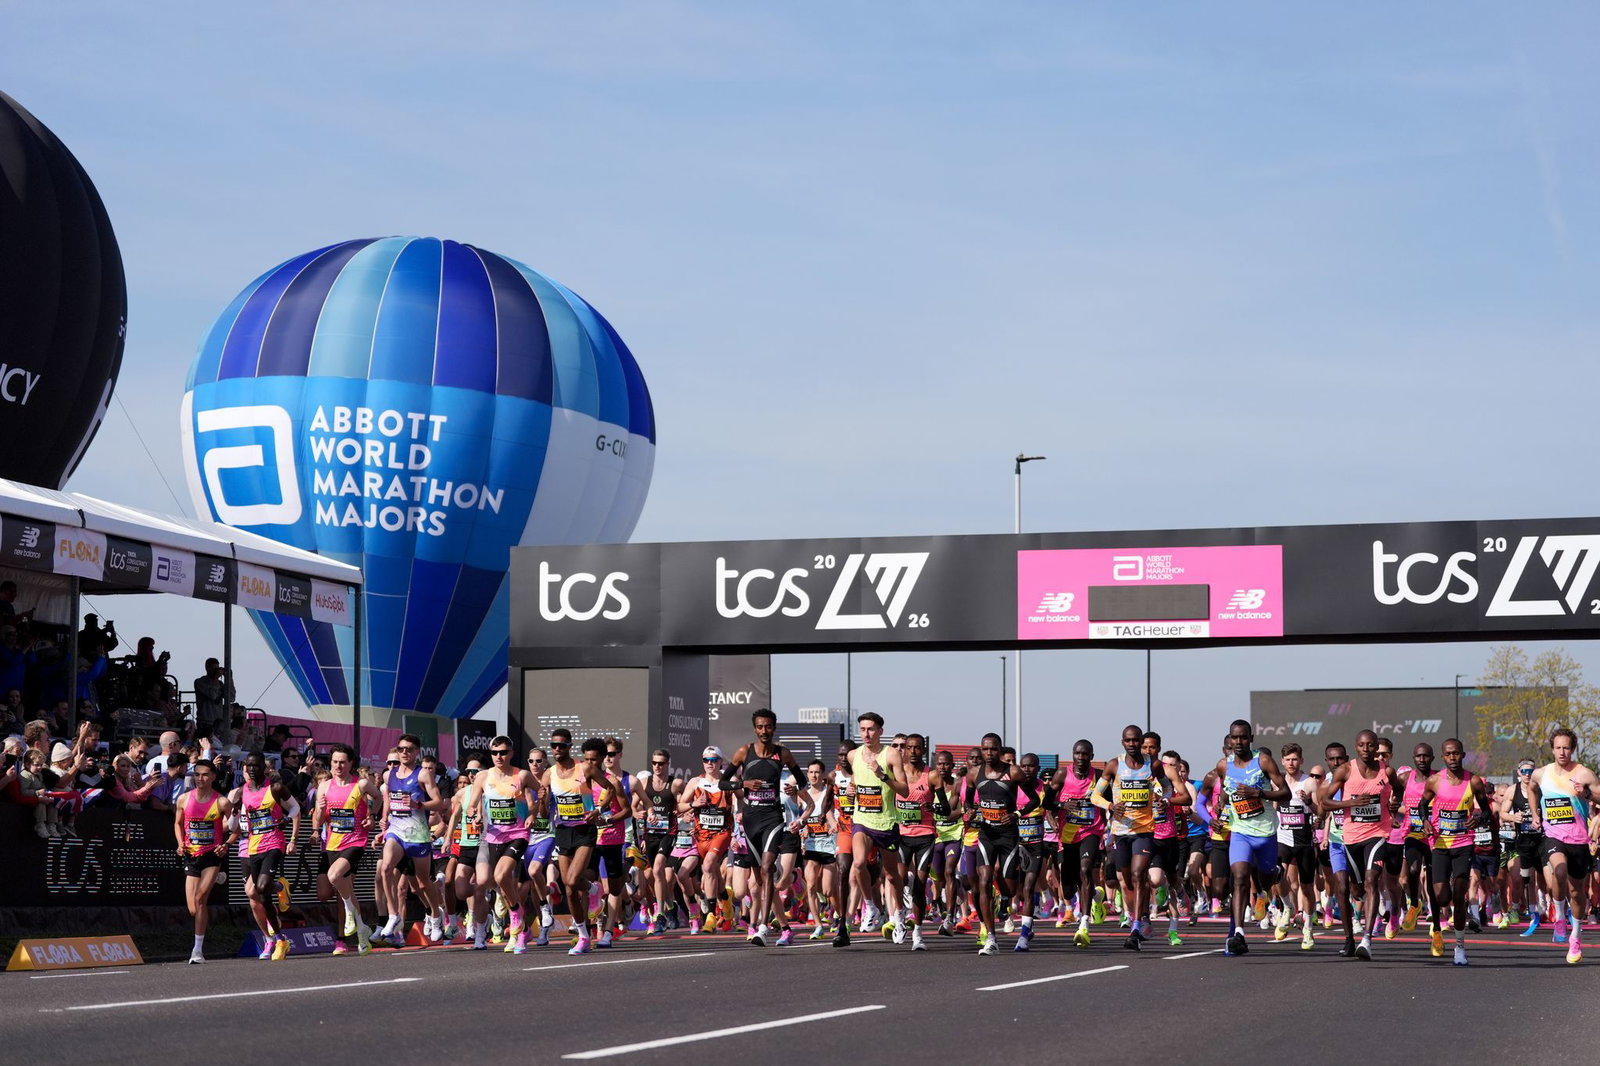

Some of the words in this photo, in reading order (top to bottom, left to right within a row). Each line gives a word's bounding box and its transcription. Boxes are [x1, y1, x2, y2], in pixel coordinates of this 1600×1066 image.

[0, 363, 41, 405] CY
[310, 405, 447, 442] ABBOTT
[310, 436, 432, 472] WORLD
[313, 471, 504, 514] MARATHON
[315, 500, 446, 536] MAJORS
[1483, 537, 1507, 552] 20
[110, 548, 126, 570] tcs
[814, 554, 835, 569] 20
[1372, 540, 1479, 605] tcs
[242, 575, 271, 598] FLORA
[279, 583, 291, 602] tcs
[539, 561, 630, 622] tcs
[715, 556, 810, 618] tcs
[315, 594, 345, 614] HubSpot
[908, 613, 929, 628] 26
[1046, 613, 1080, 622] balance
[1236, 611, 1271, 619] balance
[669, 696, 684, 711] TATA
[708, 692, 752, 705] TANCY
[669, 715, 703, 731] CONSULTANCY
[669, 733, 690, 747] SERVICES
[748, 791, 776, 800] KEJELCHA
[1122, 792, 1148, 800] KIPLIMO
[492, 810, 514, 818] DEVER
[559, 807, 583, 815] MAHAMED
[900, 811, 916, 820] TOLA
[1355, 807, 1377, 815] SAWE
[1547, 809, 1572, 818] HOGAN
[701, 816, 722, 824] SMITH
[190, 831, 207, 839] PACE
[32, 944, 84, 964] FLORA
[88, 942, 136, 962] FLORA
